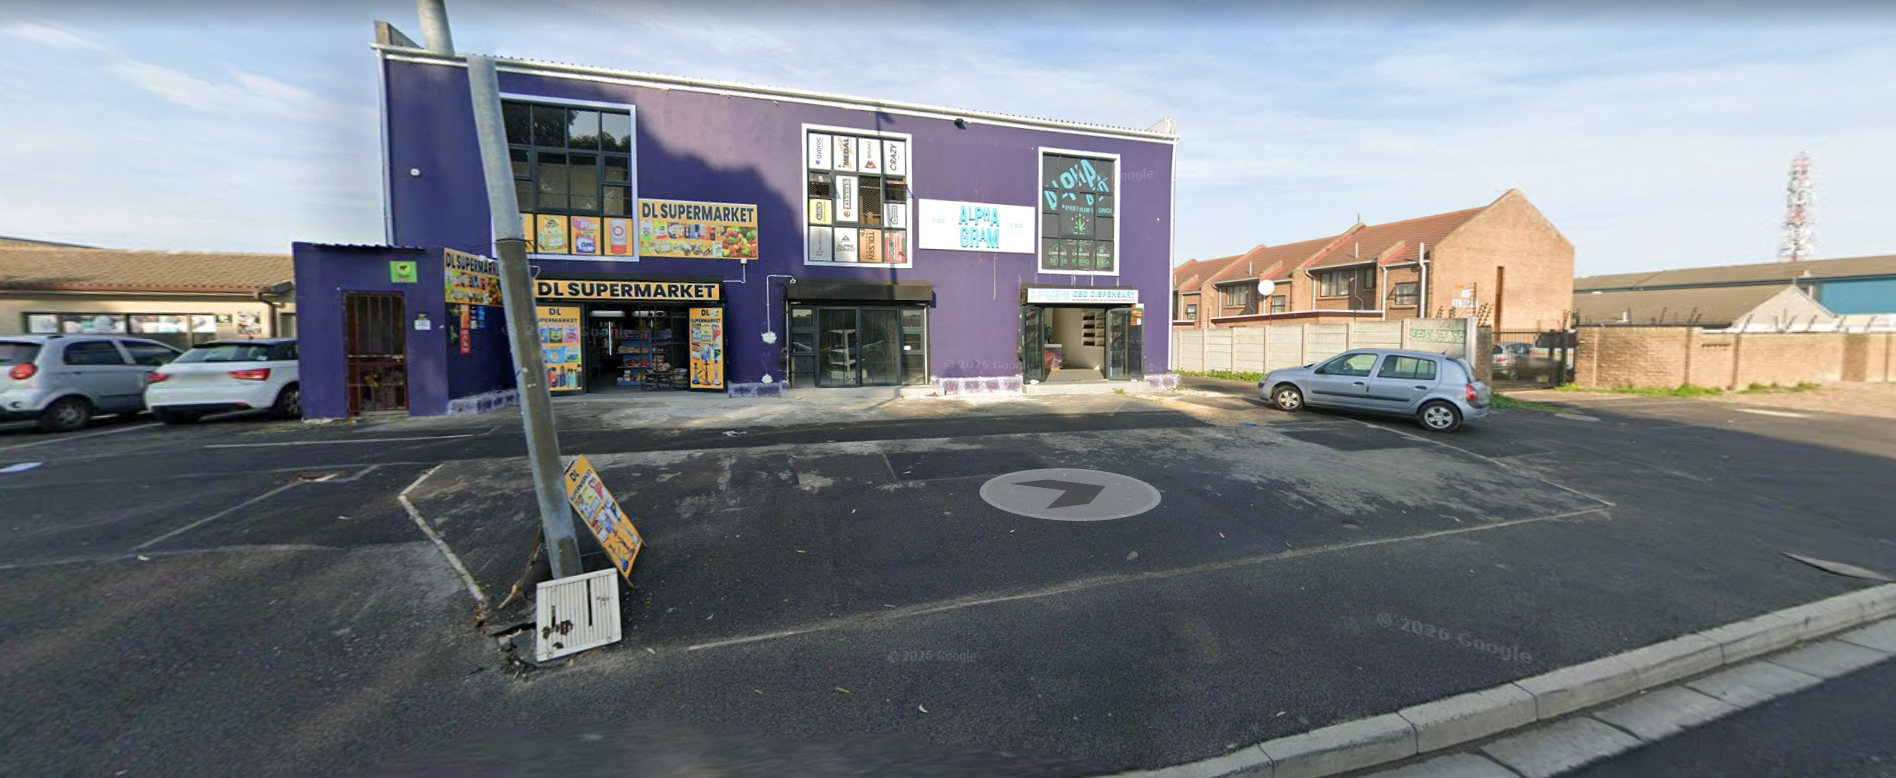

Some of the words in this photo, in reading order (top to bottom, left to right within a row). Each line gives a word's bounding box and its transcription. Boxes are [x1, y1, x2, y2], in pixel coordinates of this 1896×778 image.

[890, 143, 898, 171] CRAZY
[641, 202, 658, 219] DL
[660, 203, 754, 223] SUPERMARKET
[958, 205, 1000, 227] ALPHA
[960, 227, 1000, 249] GRAM
[446, 252, 456, 269] DL
[538, 282, 563, 297] DL
[568, 282, 716, 298] SUPERMARKET
[1073, 290, 1088, 298] CBD
[1090, 291, 1135, 299] DISPENSARY
[549, 308, 562, 316] DL
[569, 469, 580, 482] DL
